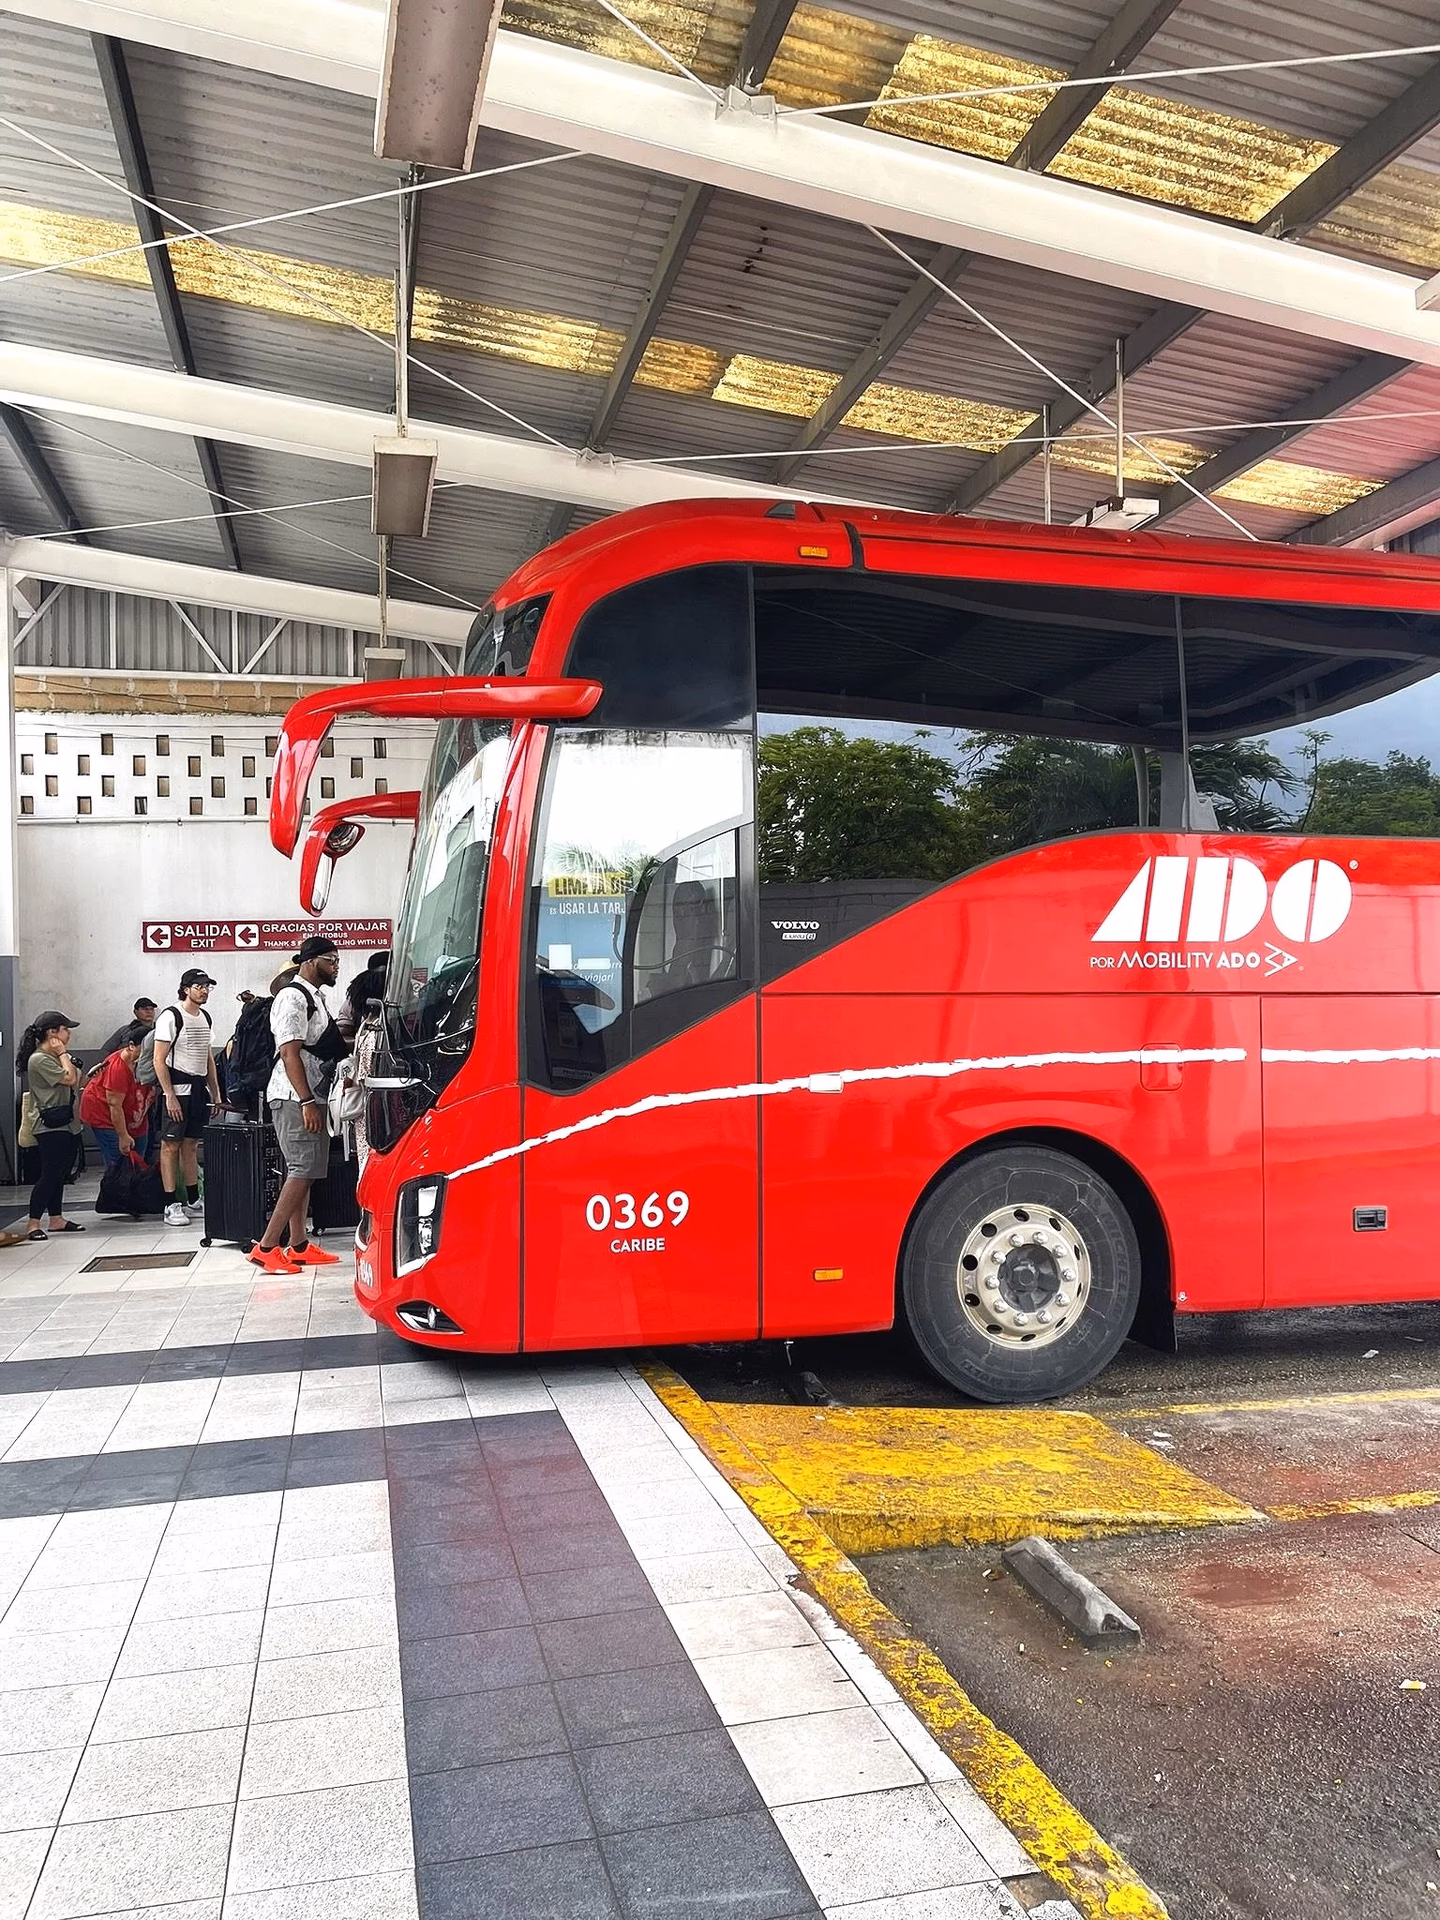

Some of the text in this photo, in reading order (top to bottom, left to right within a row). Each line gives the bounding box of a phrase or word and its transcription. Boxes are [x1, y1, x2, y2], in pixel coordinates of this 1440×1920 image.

[1090, 855, 1353, 943] ADO
[559, 902, 586, 915] USAR
[587, 902, 600, 914] LA
[174, 924, 232, 937] SALIDA
[261, 922, 388, 933] GRACIAS POR VIAJAR
[770, 921, 820, 930] VOLVO
[190, 938, 216, 948] EXIT
[1089, 951, 1261, 969] POR MOBILITY ADO
[585, 1190, 690, 1232] 0369
[610, 1237, 666, 1253] CARIBE
